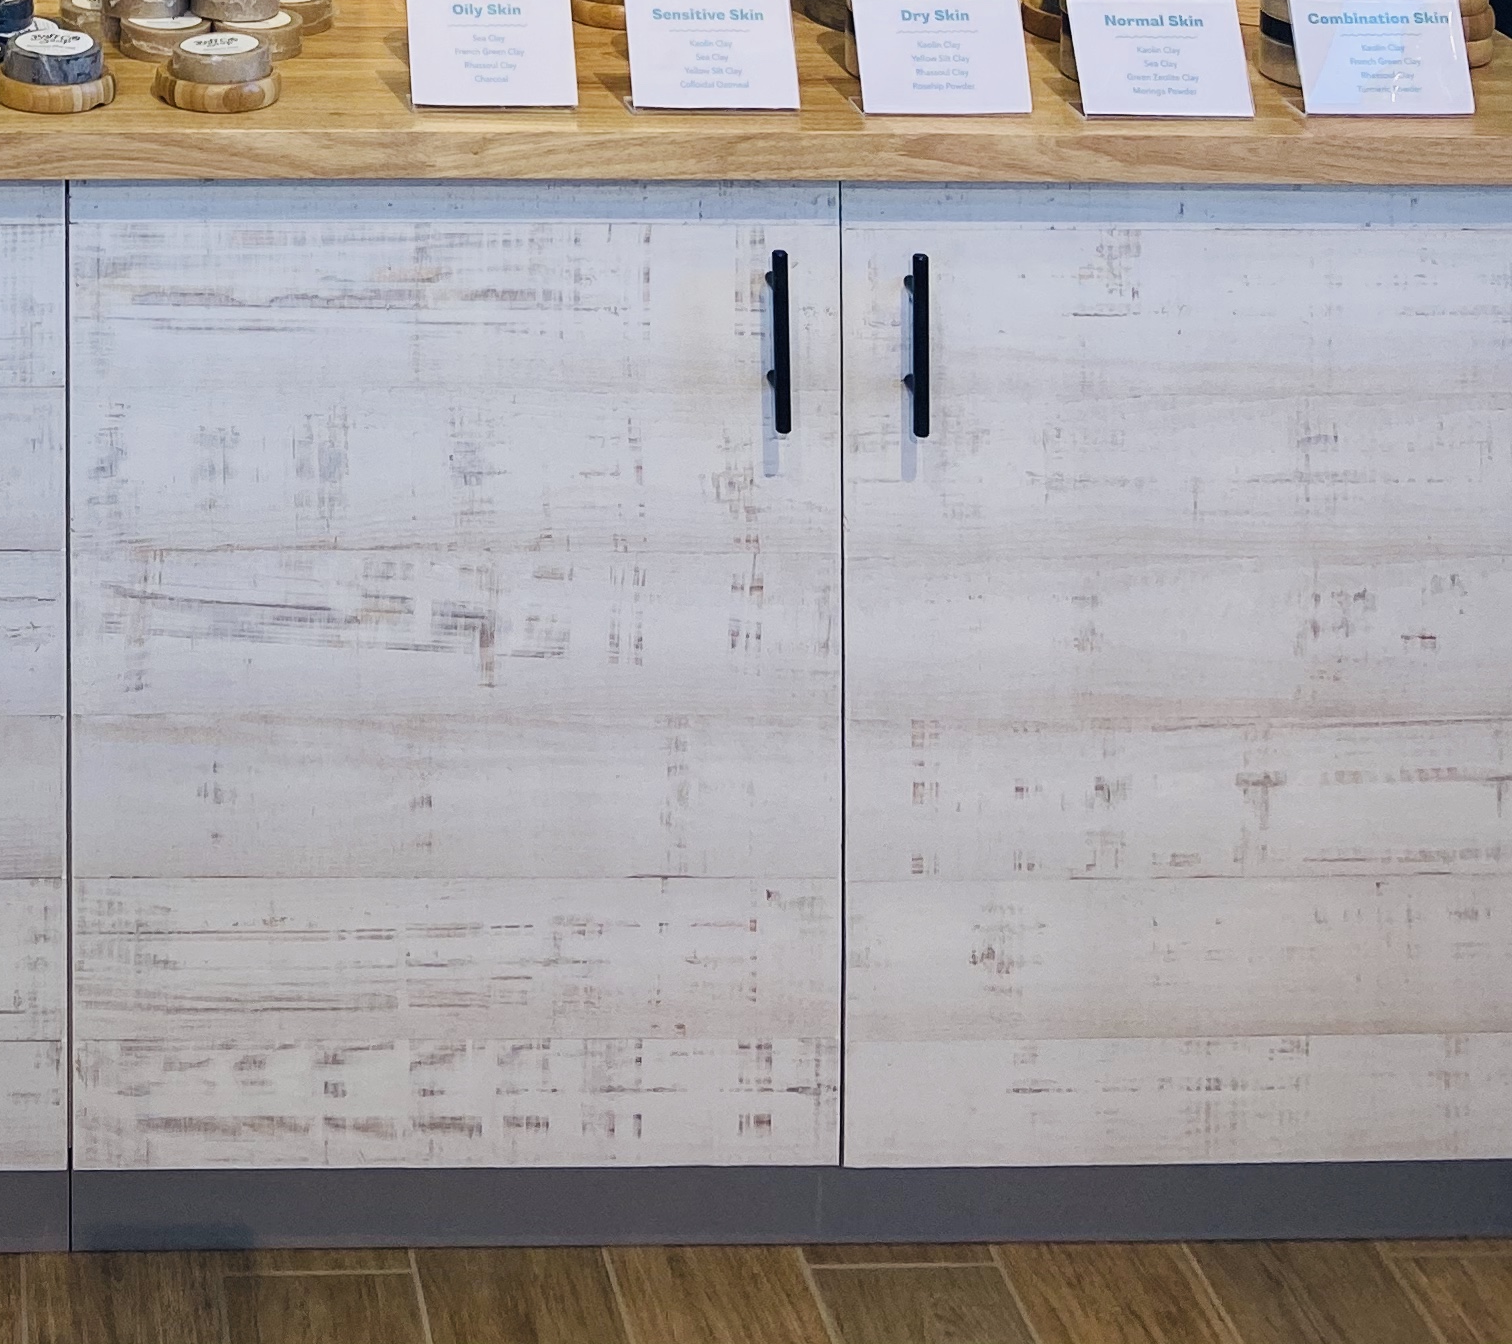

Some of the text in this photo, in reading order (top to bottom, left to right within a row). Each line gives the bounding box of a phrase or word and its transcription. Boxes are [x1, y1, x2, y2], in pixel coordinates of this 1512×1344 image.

[452, 4, 522, 19] Oily Skin
[652, 8, 764, 21] Sensitive Skin
[901, 9, 969, 25] Dry Skin
[1104, 14, 1204, 27] Normal Skin
[1308, 12, 1449, 25] Combination Skin
